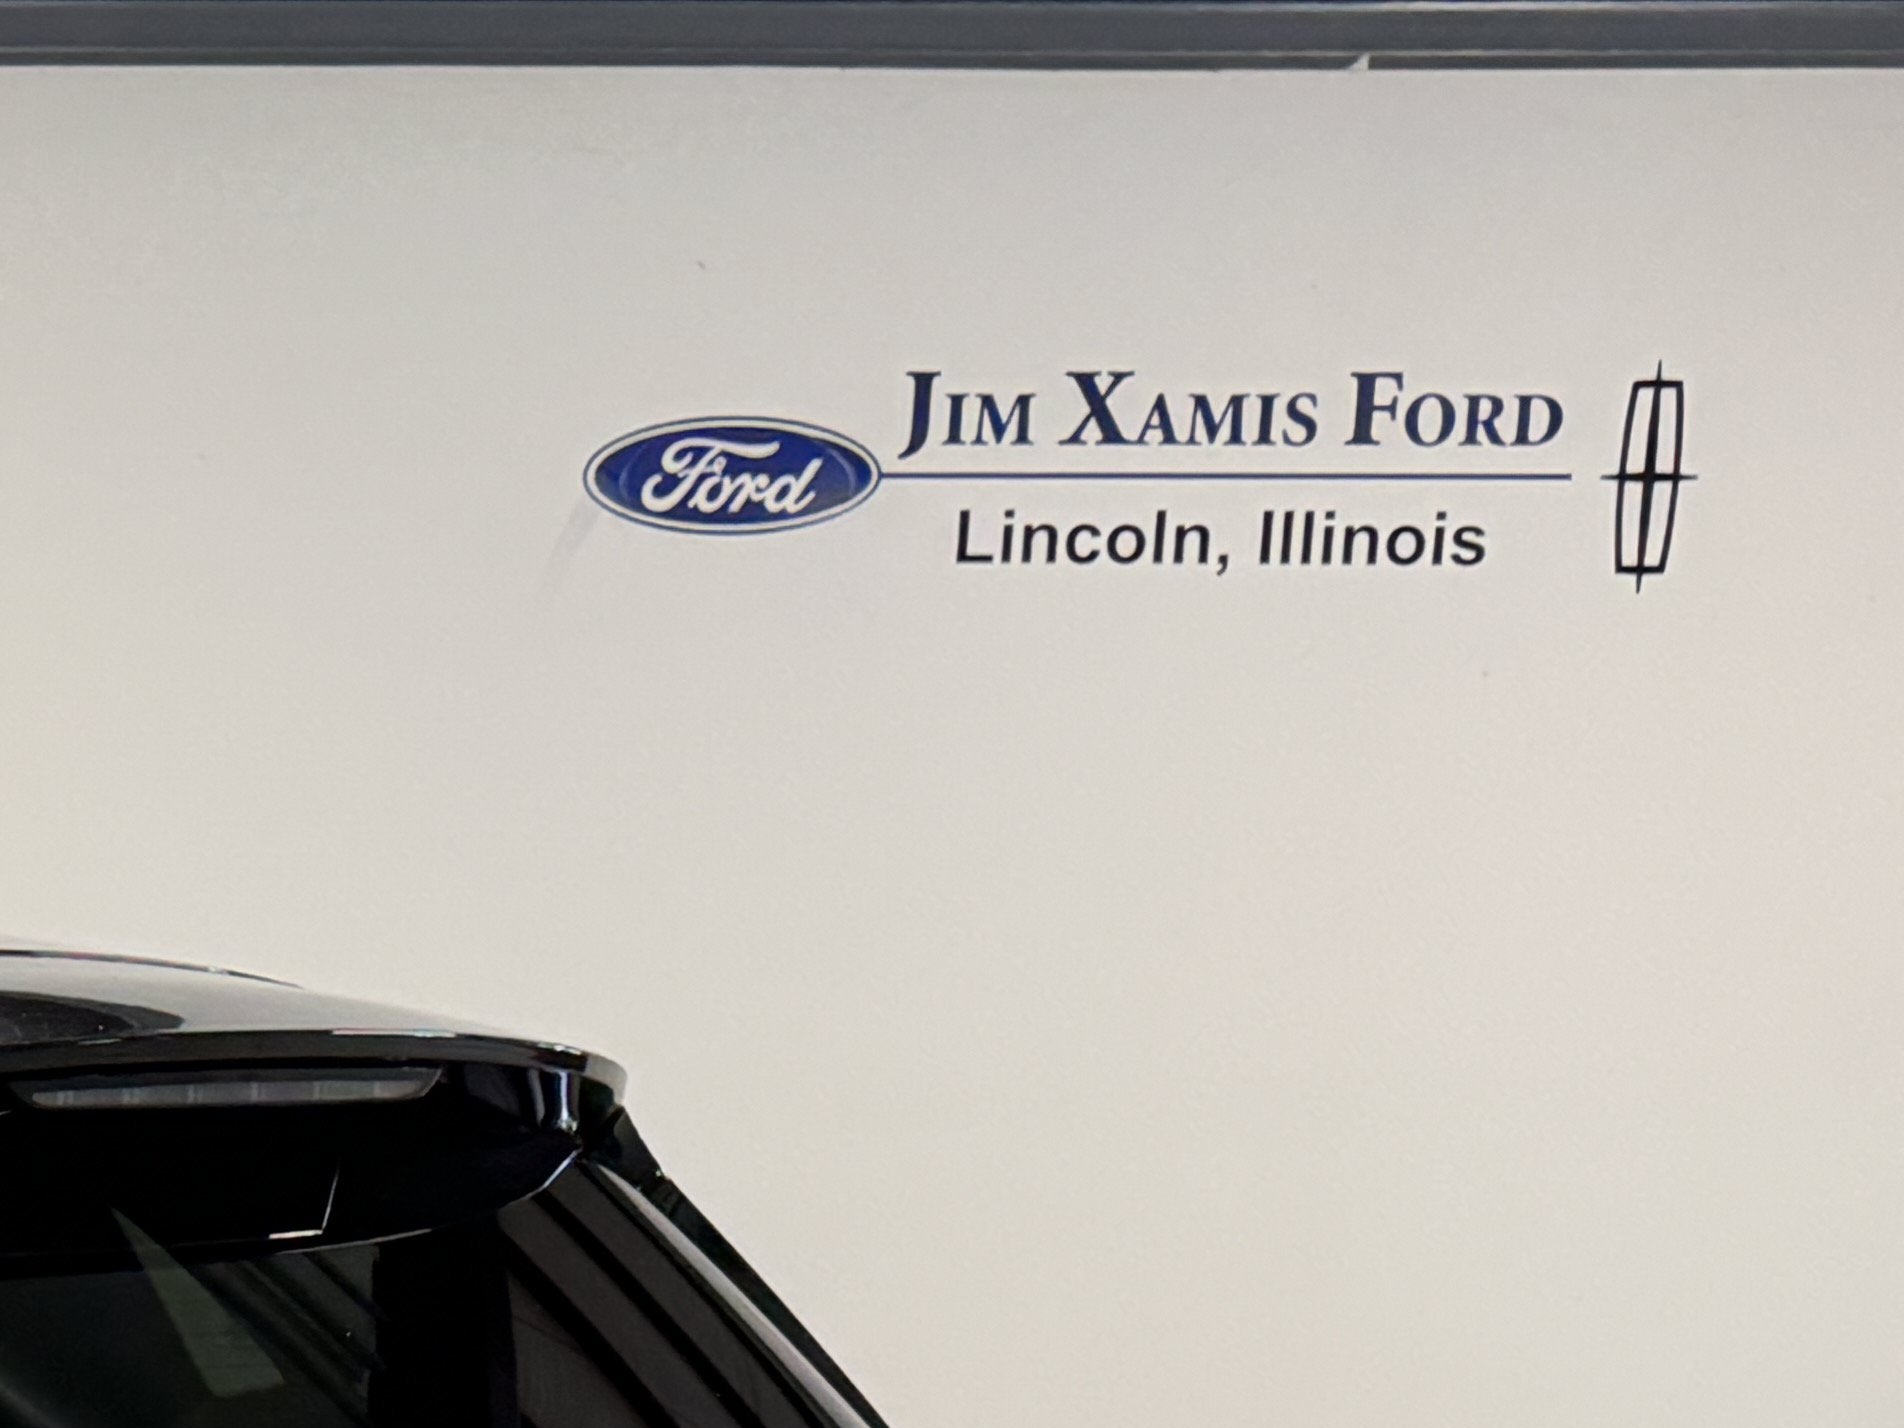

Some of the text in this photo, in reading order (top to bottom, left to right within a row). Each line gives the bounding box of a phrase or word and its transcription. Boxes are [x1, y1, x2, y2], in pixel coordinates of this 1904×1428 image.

[897, 369, 1565, 460] JIM XAMIS FORD
[641, 437, 823, 514] Ford
[956, 509, 1486, 576] Lincoln, Illinois
